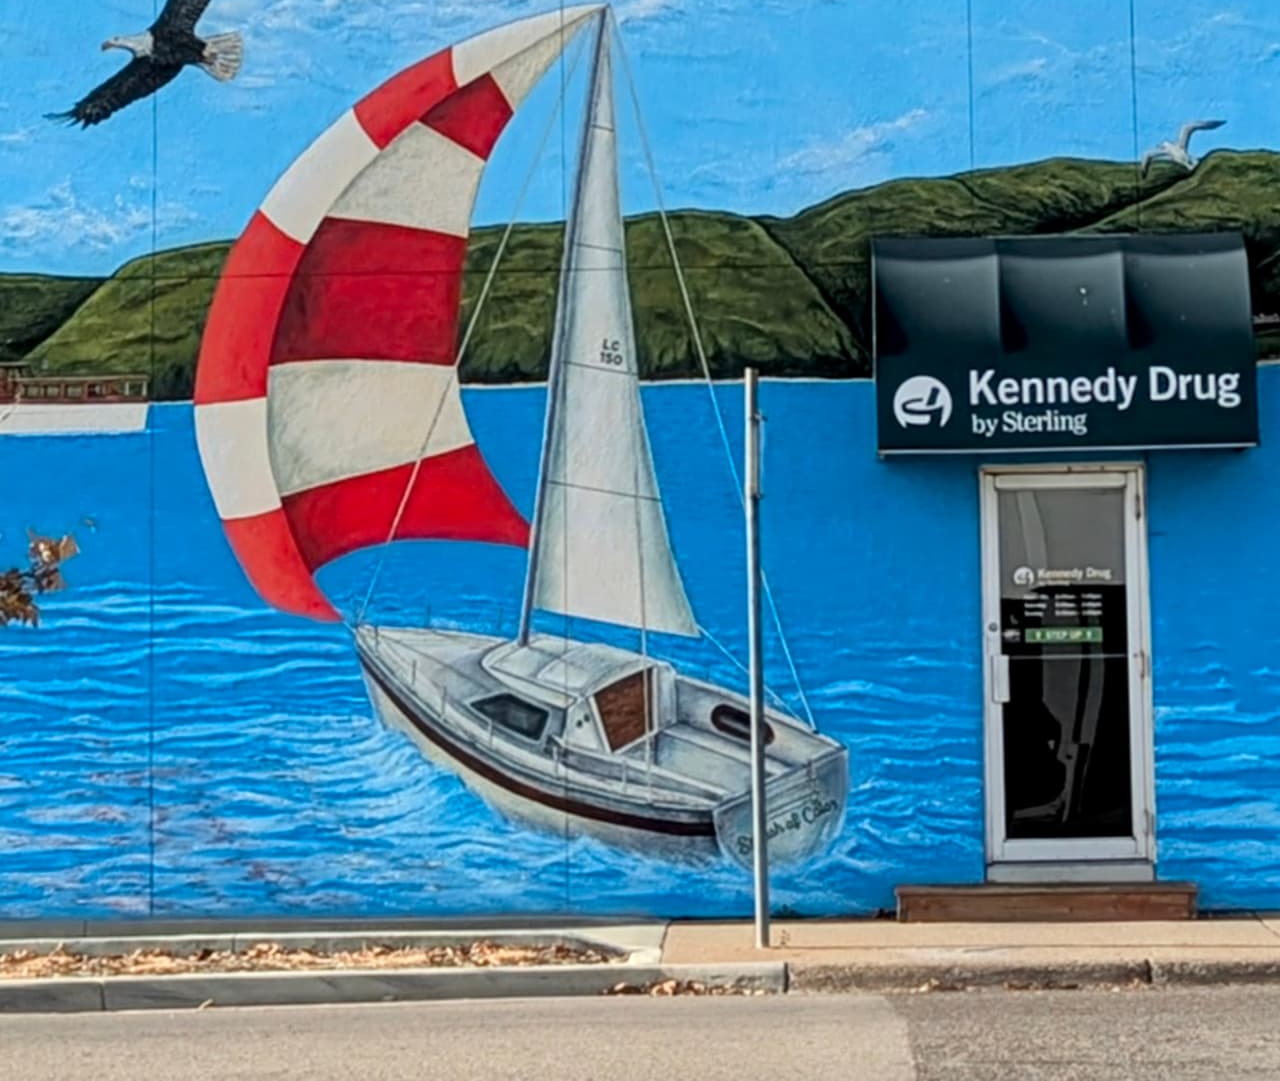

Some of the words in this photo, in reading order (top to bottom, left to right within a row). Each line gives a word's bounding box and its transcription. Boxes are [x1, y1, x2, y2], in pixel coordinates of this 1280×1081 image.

[602, 338, 620, 352] LC
[968, 367, 1138, 411] Kennedy
[1149, 366, 1241, 408] Drug
[972, 413, 999, 437] by
[1002, 409, 1088, 435] Sterling
[1037, 568, 1083, 581] Kennedy
[1085, 566, 1112, 581] Drug
